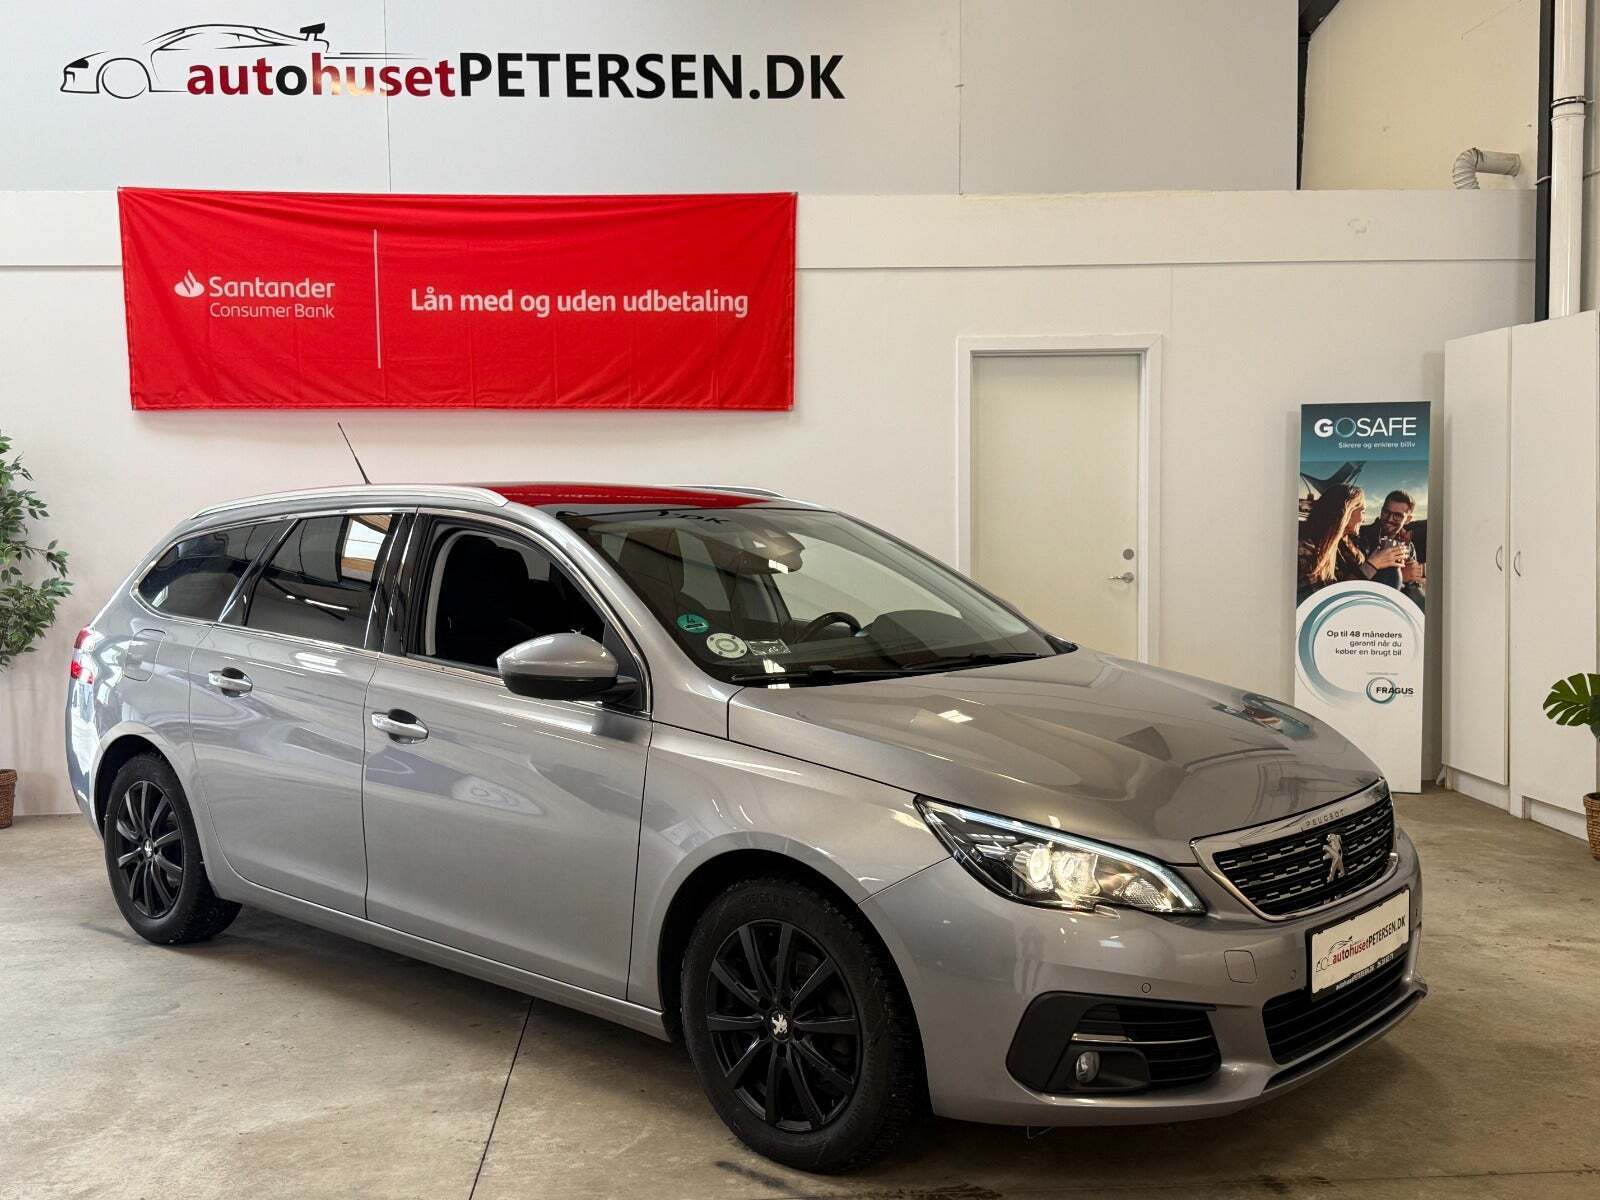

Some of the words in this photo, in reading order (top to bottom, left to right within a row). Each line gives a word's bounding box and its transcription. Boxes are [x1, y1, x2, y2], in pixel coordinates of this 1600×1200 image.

[187, 52, 846, 99] autohusetPETERSEN.DK
[208, 276, 335, 299] Santander
[209, 302, 291, 318] Consumer
[294, 303, 335, 319] Bank
[410, 286, 453, 312] Lån
[460, 289, 513, 312] med
[519, 293, 550, 318] og
[556, 289, 616, 313] uden
[623, 289, 749, 319] udbetaling
[1314, 417, 1417, 438] GOSAFE
[1326, 630, 1339, 639] Op
[1340, 630, 1348, 638] til
[1349, 630, 1361, 638] 48
[1362, 630, 1403, 639] måneders
[1349, 640, 1376, 648] garanti
[1392, 639, 1402, 648] du
[1370, 648, 1391, 657] brugt
[1392, 648, 1402, 656] bil
[1376, 686, 1414, 695] FRAGUS
[1332, 914, 1406, 965] autohusetPETERSEN.DK
